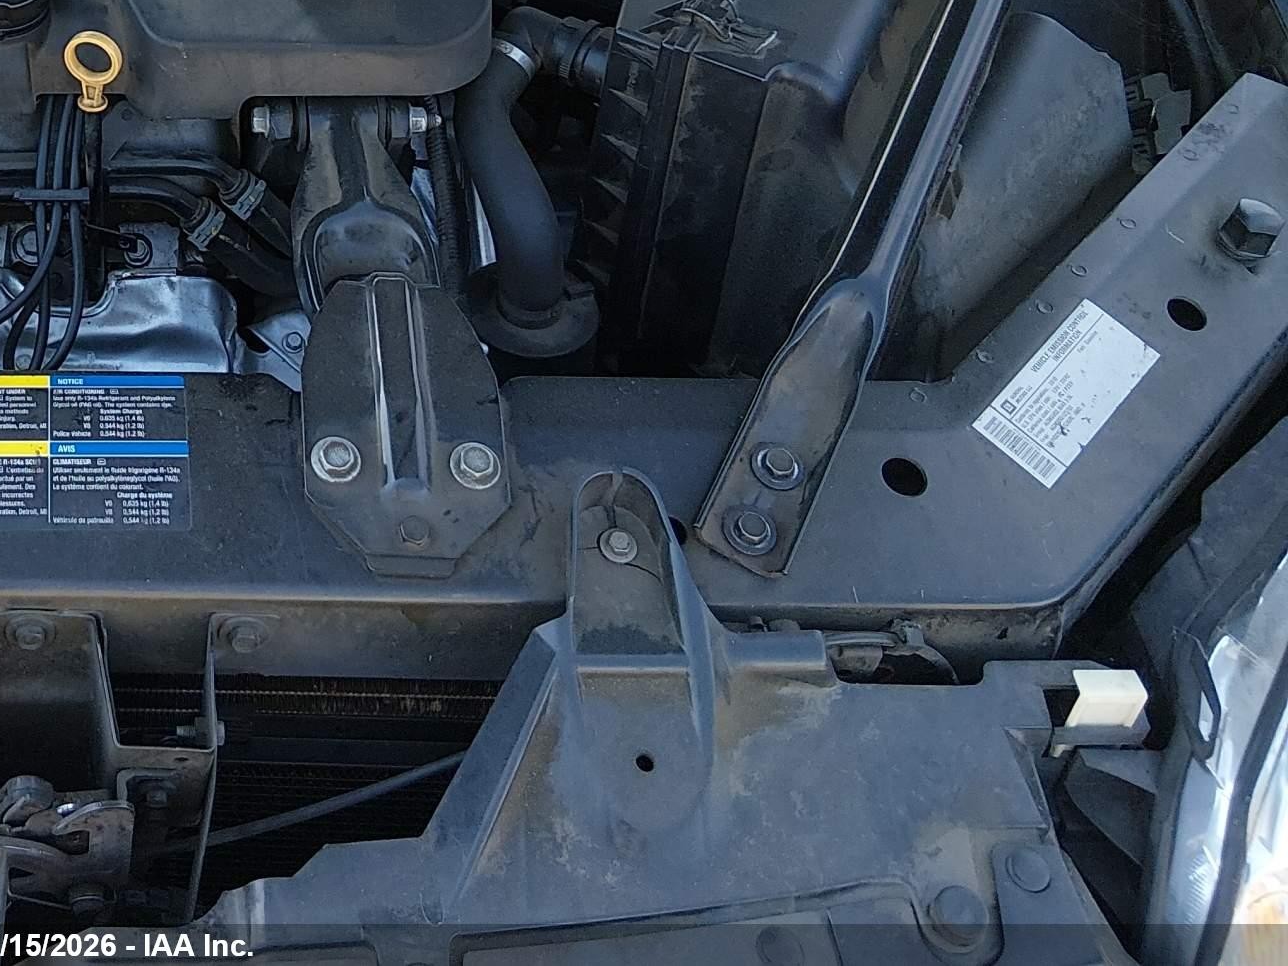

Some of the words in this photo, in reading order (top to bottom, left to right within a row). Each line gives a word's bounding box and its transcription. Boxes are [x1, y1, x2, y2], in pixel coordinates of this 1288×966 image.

[1031, 353, 1050, 373] VEHICLE
[1048, 332, 1069, 355] EMISSION
[1067, 311, 1088, 332] CONTROL
[1052, 330, 1081, 361] INFORMATION
